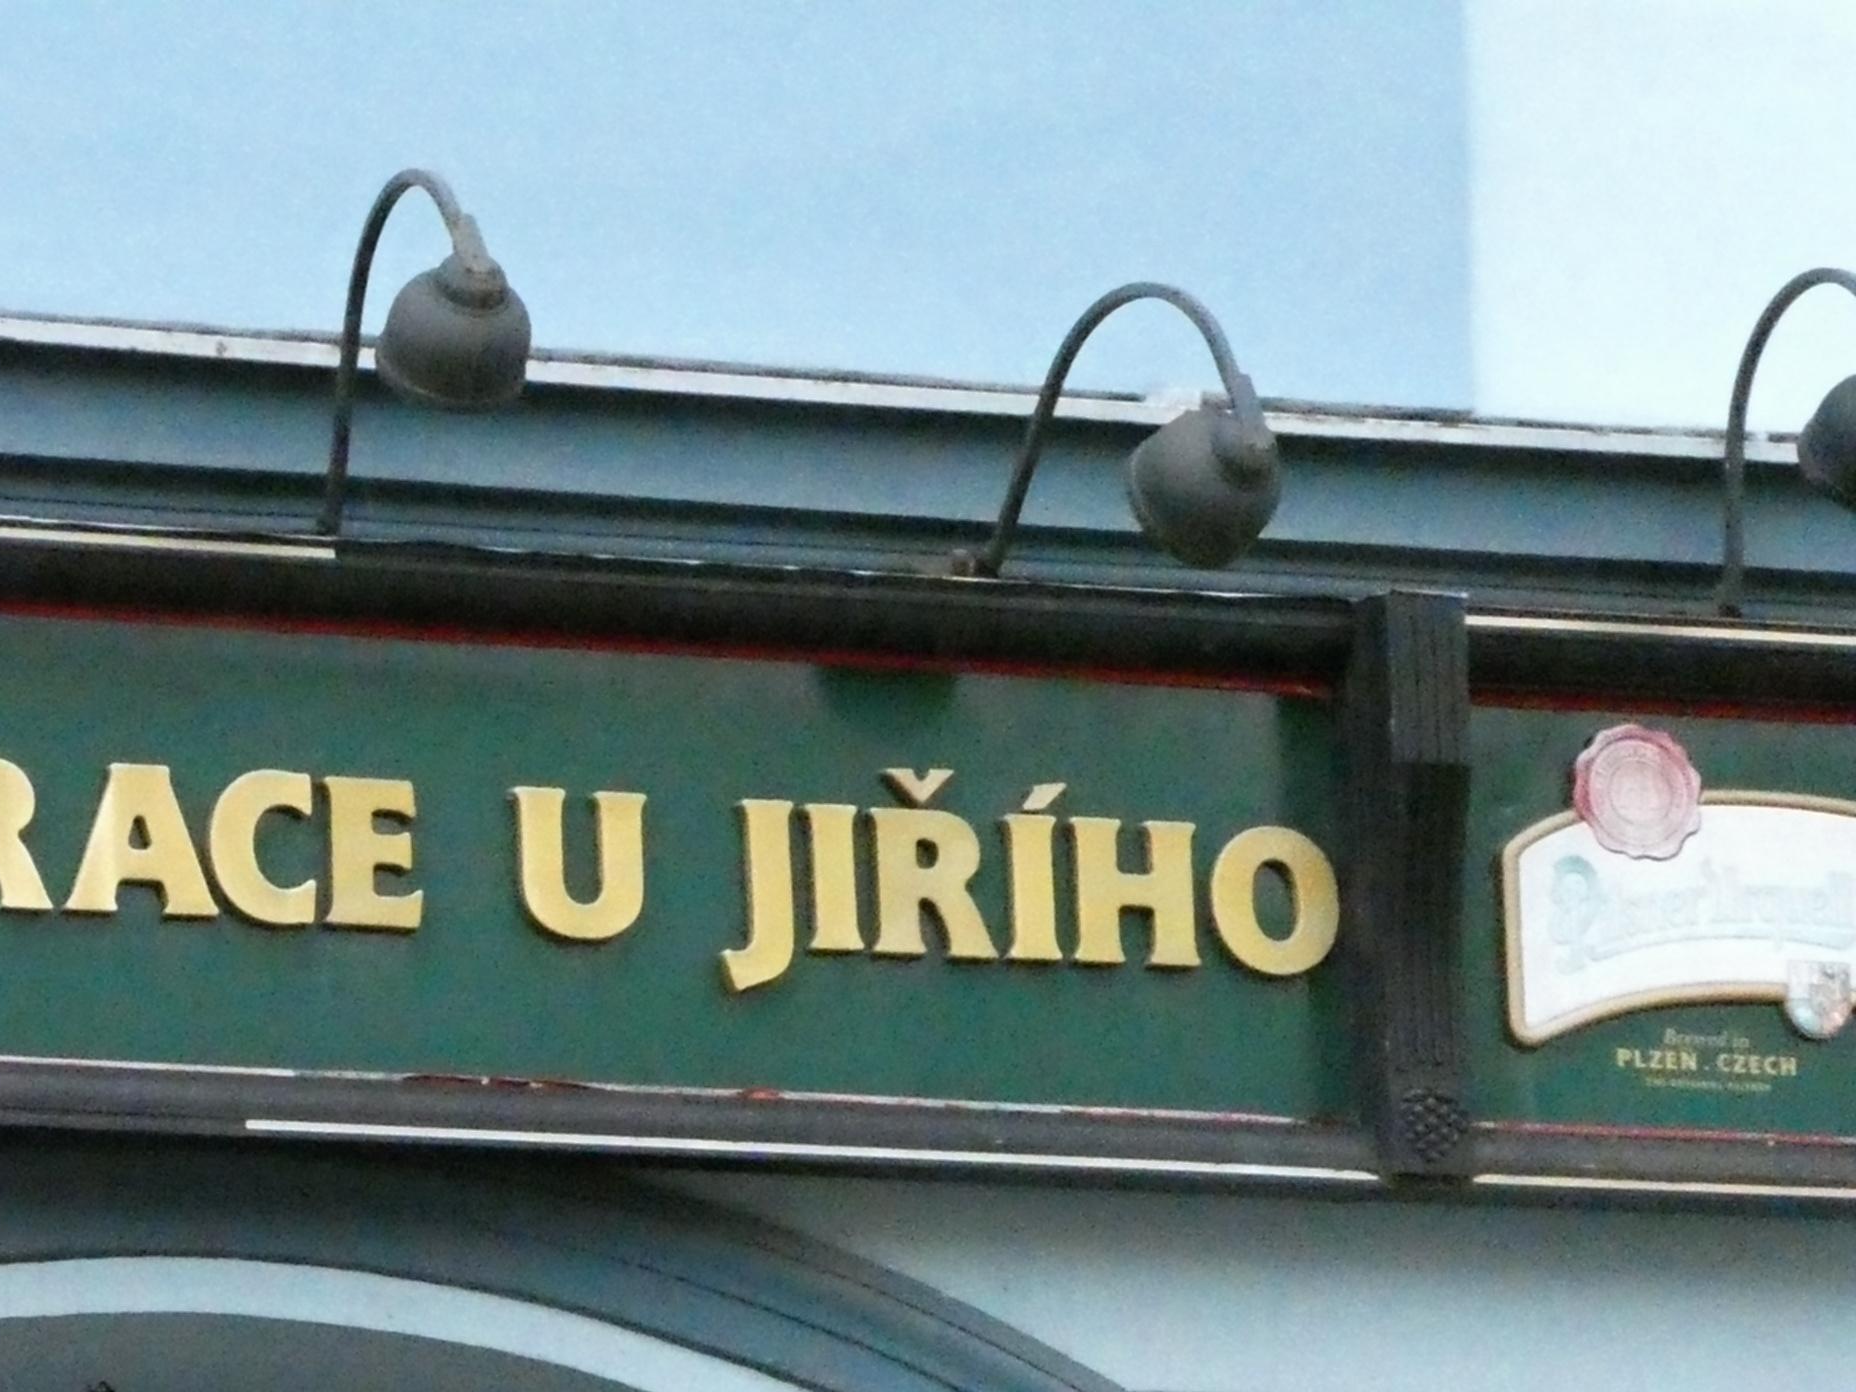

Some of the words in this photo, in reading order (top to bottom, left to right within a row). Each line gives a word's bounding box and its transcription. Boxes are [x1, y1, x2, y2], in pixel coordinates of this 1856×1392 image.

[512, 786, 647, 941] U
[721, 767, 1341, 990] JIŘÍHO
[1716, 1054, 1797, 1076] CZECH
